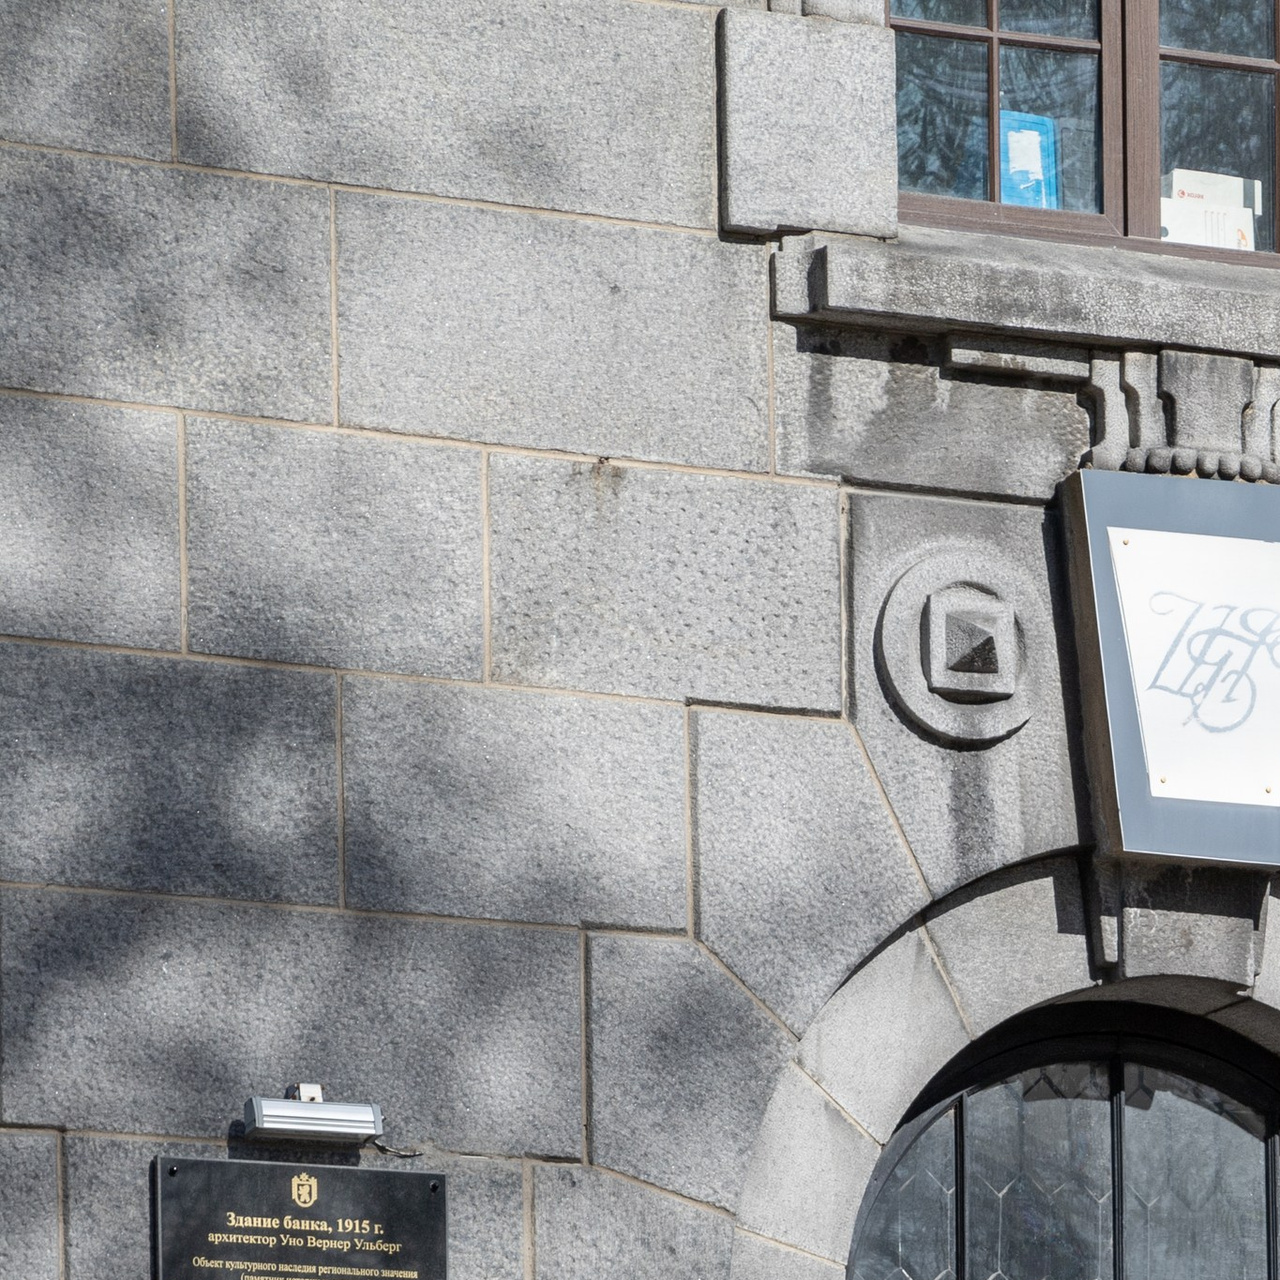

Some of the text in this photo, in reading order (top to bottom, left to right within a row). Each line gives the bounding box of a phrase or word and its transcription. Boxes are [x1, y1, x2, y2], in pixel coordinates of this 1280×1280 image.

[226, 1211, 384, 1235] Здание банка, 1915 г.
[208, 1232, 402, 1254] архитектор Уно Вернер Ульберг
[192, 1256, 418, 1279] Объект культурного наследия регионального значения
